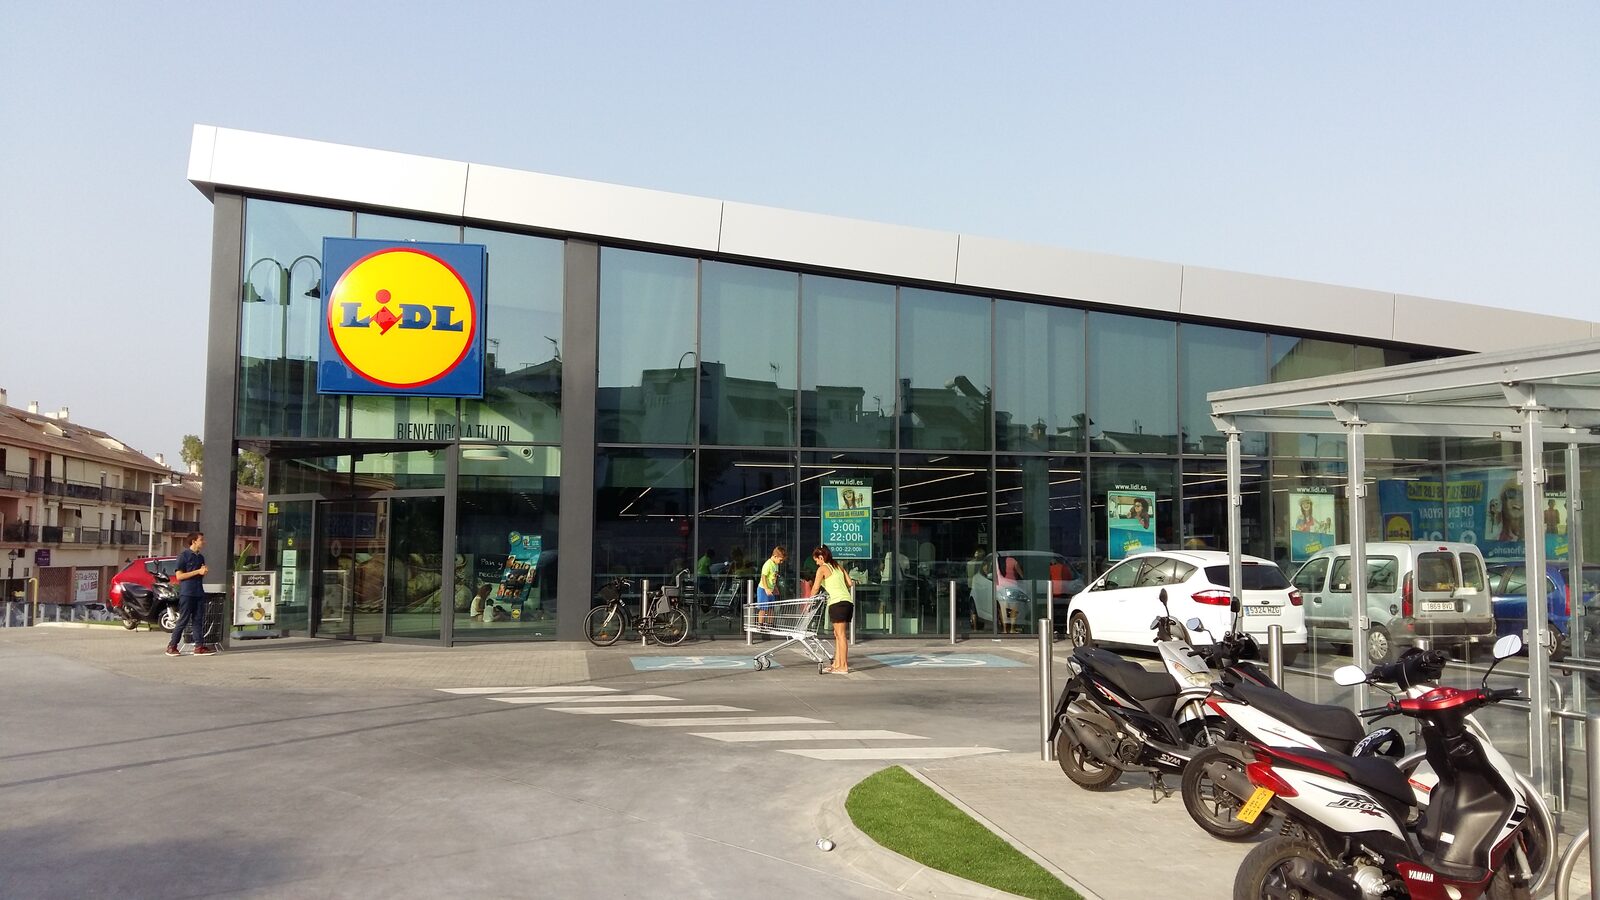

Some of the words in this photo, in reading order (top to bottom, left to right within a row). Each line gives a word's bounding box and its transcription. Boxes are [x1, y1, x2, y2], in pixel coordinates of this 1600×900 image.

[466, 424, 473, 438] A
[829, 478, 864, 486] www.lidl.es
[833, 522, 860, 532] 9:00h
[830, 532, 863, 541] 22:00h
[1250, 606, 1267, 614] 5324
[1160, 753, 1181, 766] SYM
[1326, 797, 1374, 811] JOG
[1408, 869, 1434, 883] YAMAHA
